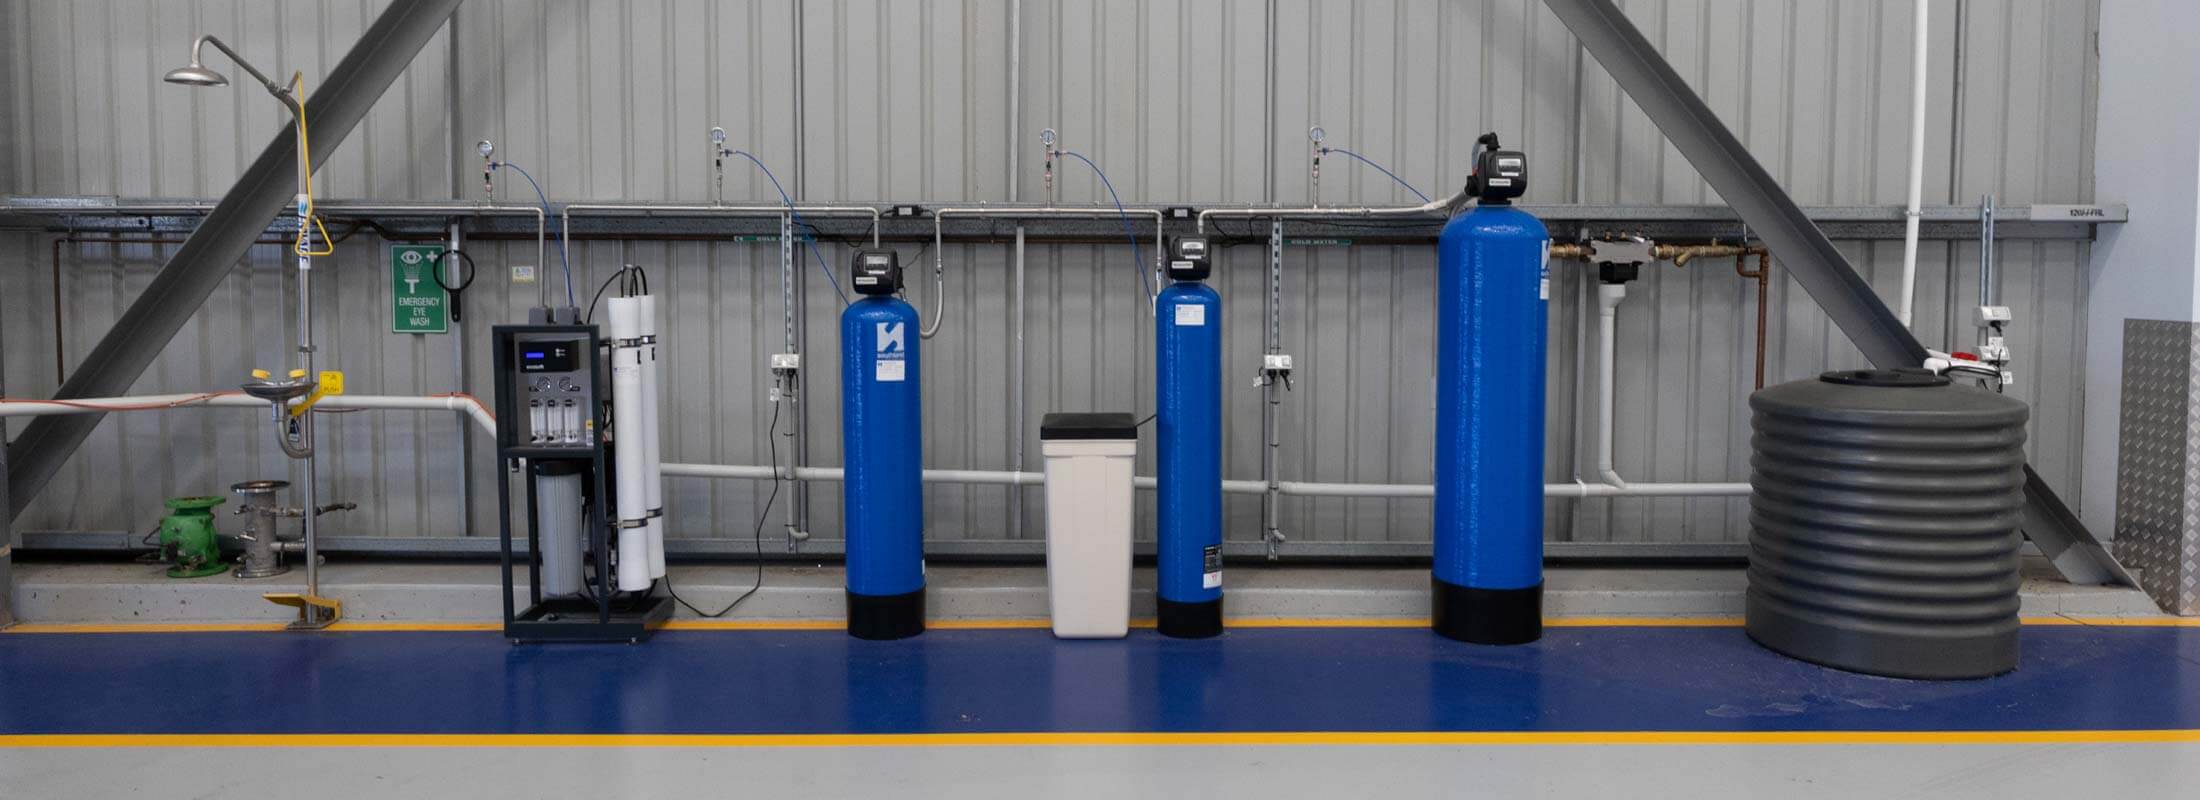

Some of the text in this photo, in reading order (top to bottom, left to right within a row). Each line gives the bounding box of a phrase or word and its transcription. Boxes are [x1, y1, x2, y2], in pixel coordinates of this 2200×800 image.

[399, 297, 440, 306] EMERGENCY
[413, 307, 426, 316] EYE
[410, 317, 430, 326] WASH
